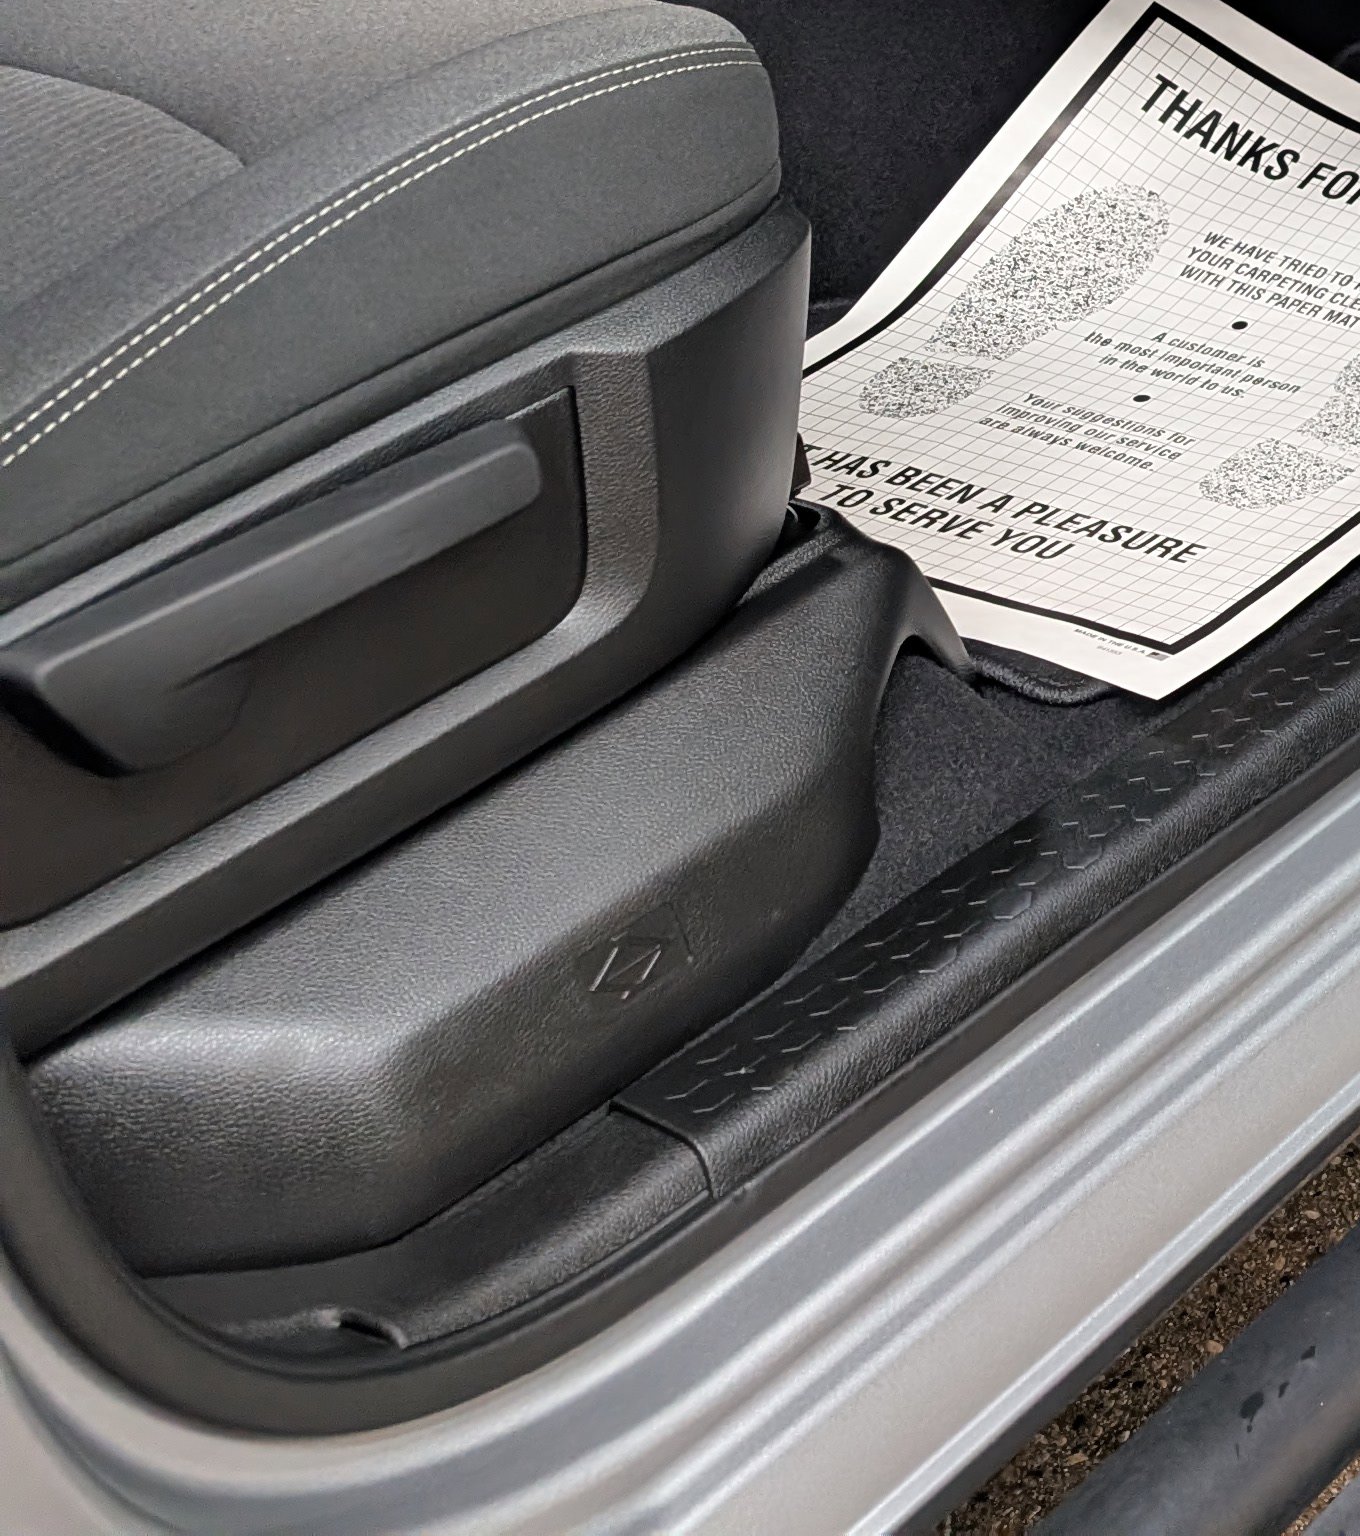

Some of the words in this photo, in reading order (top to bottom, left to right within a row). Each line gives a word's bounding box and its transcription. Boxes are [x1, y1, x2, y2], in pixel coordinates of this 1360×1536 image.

[1141, 73, 1300, 180] THANKS
[1187, 246, 1234, 271] YOUR
[1235, 263, 1329, 300] CARPETING
[1203, 232, 1233, 250] WE
[1231, 241, 1278, 264] HAVE
[1278, 255, 1328, 280] TRIED
[1330, 271, 1354, 287] TO
[1179, 264, 1226, 287] WITH
[1226, 278, 1266, 301] THIS
[1266, 293, 1322, 317] PAPER
[1084, 331, 1111, 347] the
[1114, 341, 1158, 358] most
[1158, 351, 1241, 379] important
[1239, 372, 1301, 394] person
[1099, 353, 1116, 365] in
[1119, 360, 1148, 373] the
[1150, 367, 1201, 386] world
[1200, 378, 1219, 391] to
[1221, 386, 1245, 398] us.
[1151, 332, 1168, 343] A
[1168, 338, 1246, 363] customer
[1248, 356, 1265, 369] is
[979, 416, 1011, 430] are
[1011, 424, 1072, 447] always
[1075, 441, 1155, 472] welcome.
[996, 403, 1083, 433] improving
[1084, 428, 1116, 441] our
[1116, 436, 1182, 460] service
[1022, 393, 1062, 410] Your
[1063, 406, 1165, 438] suggestions
[1166, 432, 1196, 446] for
[811, 450, 892, 479] HAS
[884, 466, 987, 504] BEEN
[976, 494, 1015, 513] A
[1011, 501, 1207, 563] PLEASURE
[818, 484, 874, 508] TO
[869, 498, 995, 539] SERVE
[990, 528, 1076, 559] YOU
